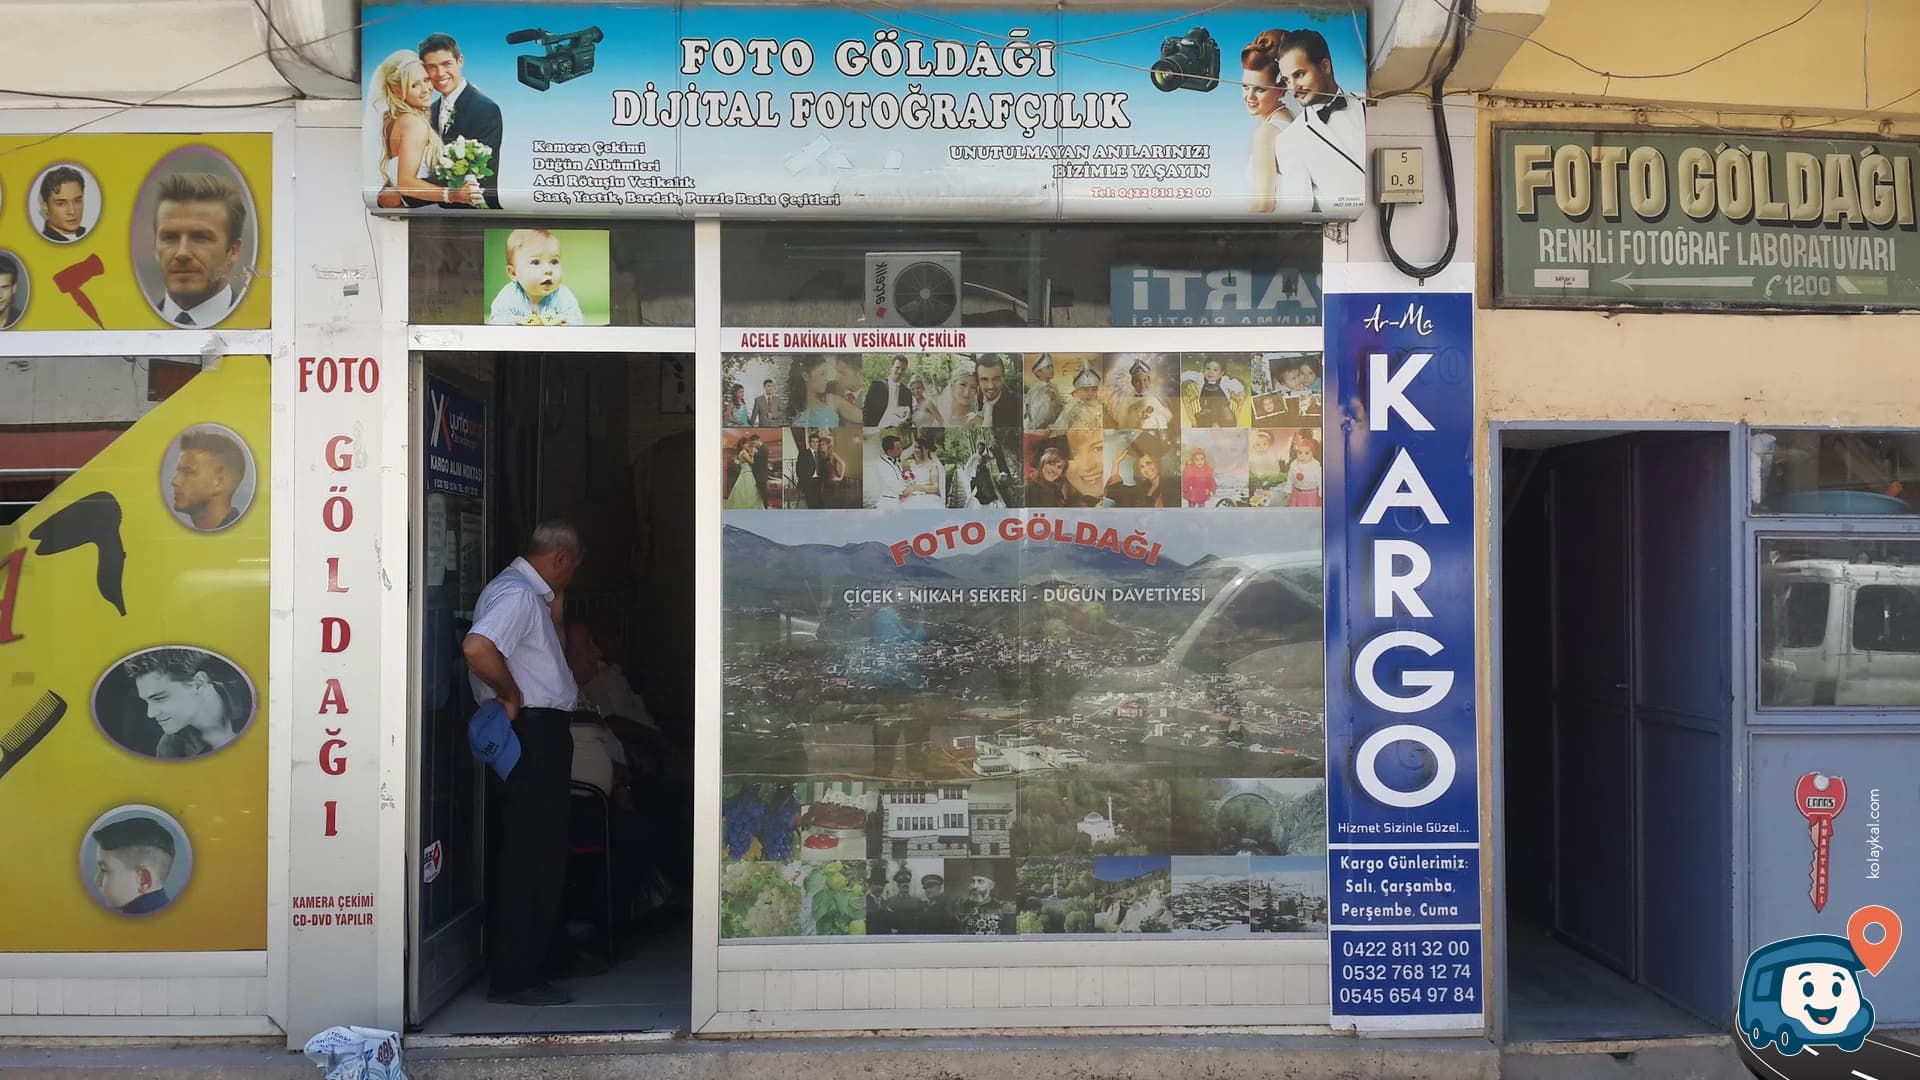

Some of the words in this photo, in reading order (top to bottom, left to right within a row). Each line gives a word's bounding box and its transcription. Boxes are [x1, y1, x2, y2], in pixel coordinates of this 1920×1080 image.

[680, 38, 814, 76] FOTO
[612, 82, 780, 128] DİJİTAL
[790, 83, 1131, 138] FOTOĞRAFÇILIK
[533, 140, 590, 153] Kamera
[593, 141, 646, 156] Çekimi
[950, 145, 1090, 160] UNUTULMAYAN
[1093, 145, 1211, 160] ANILARINIZI
[533, 158, 582, 172] Düğün
[585, 158, 660, 172] Albümleri
[1401, 152, 1408, 163] 5
[1052, 162, 1128, 179] BİZİMLE
[1131, 164, 1210, 181] YAŞAYIN
[1408, 174, 1414, 185] 8
[533, 175, 564, 187] Acil
[567, 175, 625, 190] Rötuşlu
[628, 176, 695, 188] Vesikalık
[1514, 144, 1667, 219] FOTO
[534, 191, 571, 204] Saat,
[573, 191, 623, 205] Yastık,
[625, 192, 683, 206] Bardak,
[685, 192, 733, 205] Puzzle
[735, 193, 776, 205] Baskı
[779, 193, 841, 207] Çeşitleri
[1091, 187, 1115, 199] Tel:
[1118, 188, 1148, 199] 0422
[1152, 188, 1174, 199] 811
[1177, 188, 1194, 199] 32
[1196, 188, 1211, 198] 00
[1620, 226, 1730, 266] FOTOĞRAF
[1737, 232, 1896, 272] LABORATUVARI
[1785, 275, 1831, 297] 1200
[1363, 303, 1434, 335] Ar-Ma
[741, 332, 779, 348] ACELE
[784, 329, 847, 348] DAKİKALIK
[853, 329, 915, 348] VESİKALIK
[919, 329, 966, 351] ÇEKİLİR
[297, 357, 379, 393] FOTO
[888, 521, 986, 568] FOTO
[999, 513, 1162, 567] GÖLDAĞI
[1354, 353, 1456, 808] KARGO
[843, 586, 894, 606] ÇİÇEK
[909, 585, 964, 603] NİKAH
[970, 585, 1027, 607] ŞEKERİ
[1044, 584, 1106, 603] DÜĞÜN
[1112, 583, 1206, 603] DAVETİYESİ
[318, 434, 354, 837] GÖLDAĞI
[1338, 822, 1381, 833] Hizmet
[1384, 822, 1423, 833] Sizinle
[1426, 822, 1470, 833] Güzel...
[1341, 856, 1383, 873] Kargo
[1388, 855, 1469, 870] Günlerimiz:
[1346, 879, 1376, 894] Salı,
[1380, 878, 1456, 897] Çarşamba,
[293, 896, 335, 909] KAMERA
[338, 892, 374, 911] ÇEKİMİ
[293, 914, 332, 926] CD-DVD
[335, 913, 373, 926] YAPILIR
[1341, 903, 1415, 921] Perşembe,
[1420, 903, 1458, 916] Cuma
[1343, 942, 1387, 957] 0422
[1391, 942, 1417, 957] 811
[1422, 941, 1443, 956] 32
[1448, 940, 1470, 956] 00
[1342, 965, 1387, 981] 0532
[1391, 965, 1425, 980] 768
[1430, 965, 1447, 979] 12
[1452, 964, 1471, 979] 74
[1339, 988, 1384, 1004] 0545
[1389, 988, 1422, 1003] 654
[1427, 988, 1448, 1003] 97
[1453, 987, 1475, 1002] 84
